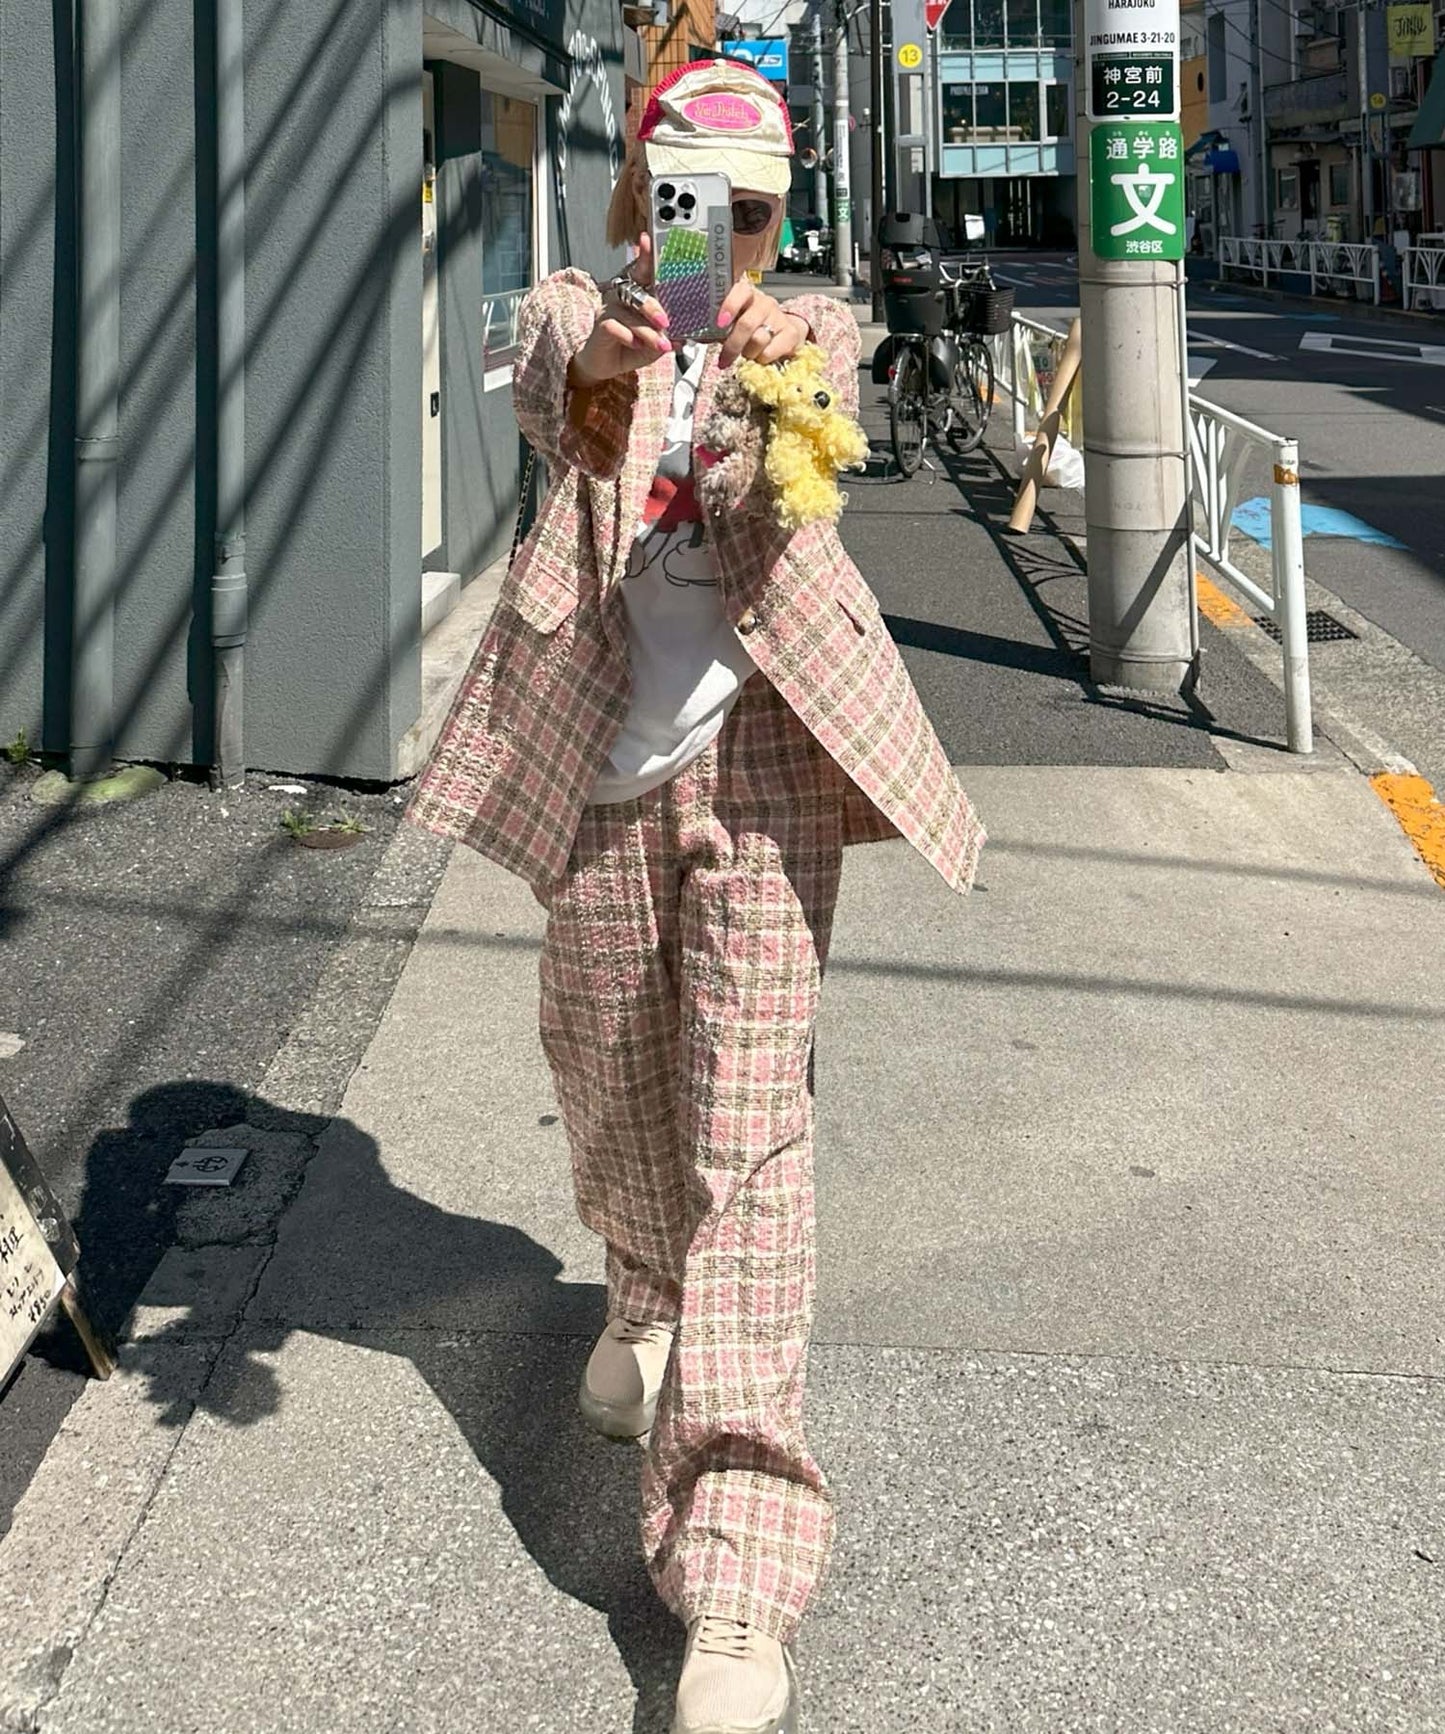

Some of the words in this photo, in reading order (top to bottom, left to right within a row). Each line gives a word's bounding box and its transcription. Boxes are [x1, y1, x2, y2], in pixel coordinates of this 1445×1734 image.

[1090, 33, 1139, 46] JINGUMAE
[902, 50, 919, 63] 13
[1103, 66, 1163, 85] 神宮前
[1106, 90, 1160, 108] 2-24
[1106, 136, 1178, 159] 通学路
[1110, 163, 1177, 236] 文
[714, 223, 725, 270] TOKYO
[1126, 240, 1163, 254] 渋谷区
